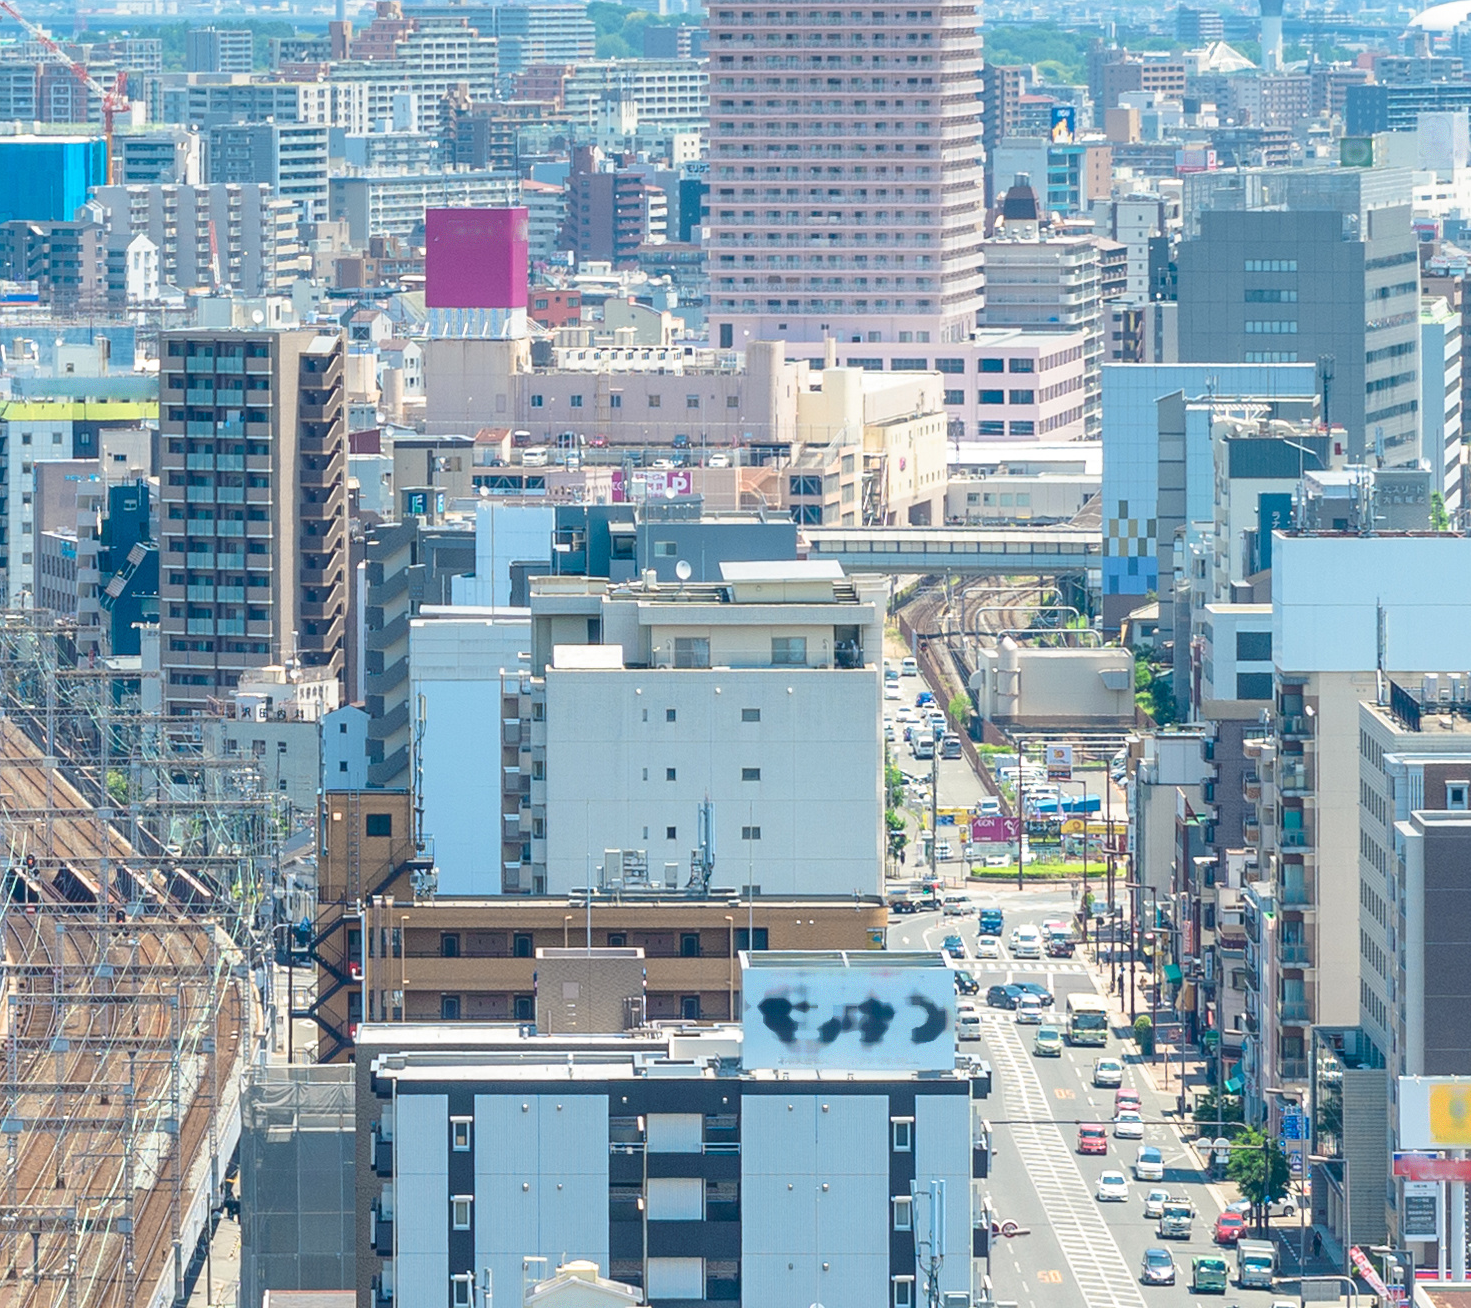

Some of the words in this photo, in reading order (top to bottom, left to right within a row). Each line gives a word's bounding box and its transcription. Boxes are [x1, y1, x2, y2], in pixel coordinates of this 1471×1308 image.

[672, 476, 688, 495] P
[1383, 485, 1426, 494] エスリード
[1037, 1269, 1063, 1284] 50
